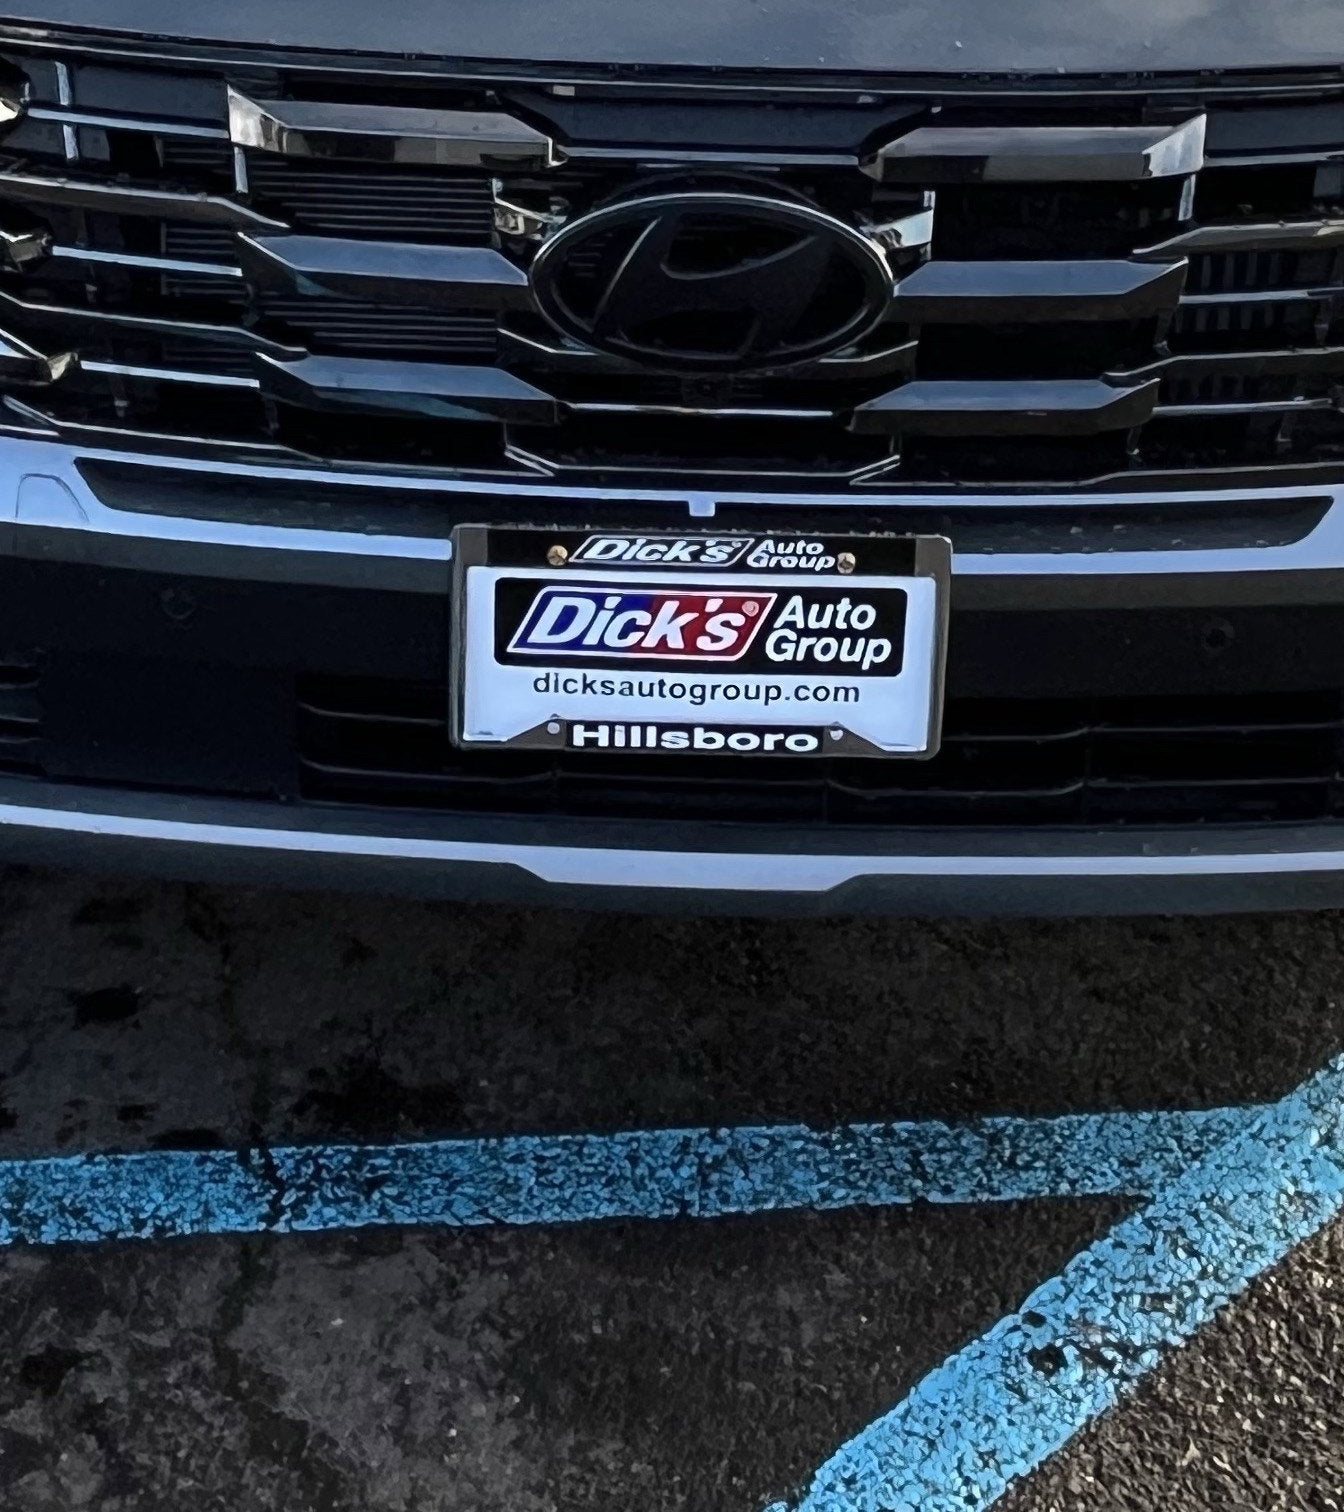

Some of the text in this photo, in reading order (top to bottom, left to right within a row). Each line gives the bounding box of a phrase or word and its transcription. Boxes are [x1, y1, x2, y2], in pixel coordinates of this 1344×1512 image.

[747, 548, 836, 571] Group
[755, 539, 824, 555] Auto
[526, 595, 746, 651] Dick's
[773, 595, 876, 630] Auto
[765, 629, 892, 669] Group
[533, 672, 860, 705] dicksautogroup.com
[572, 724, 819, 752] Hillsboro
